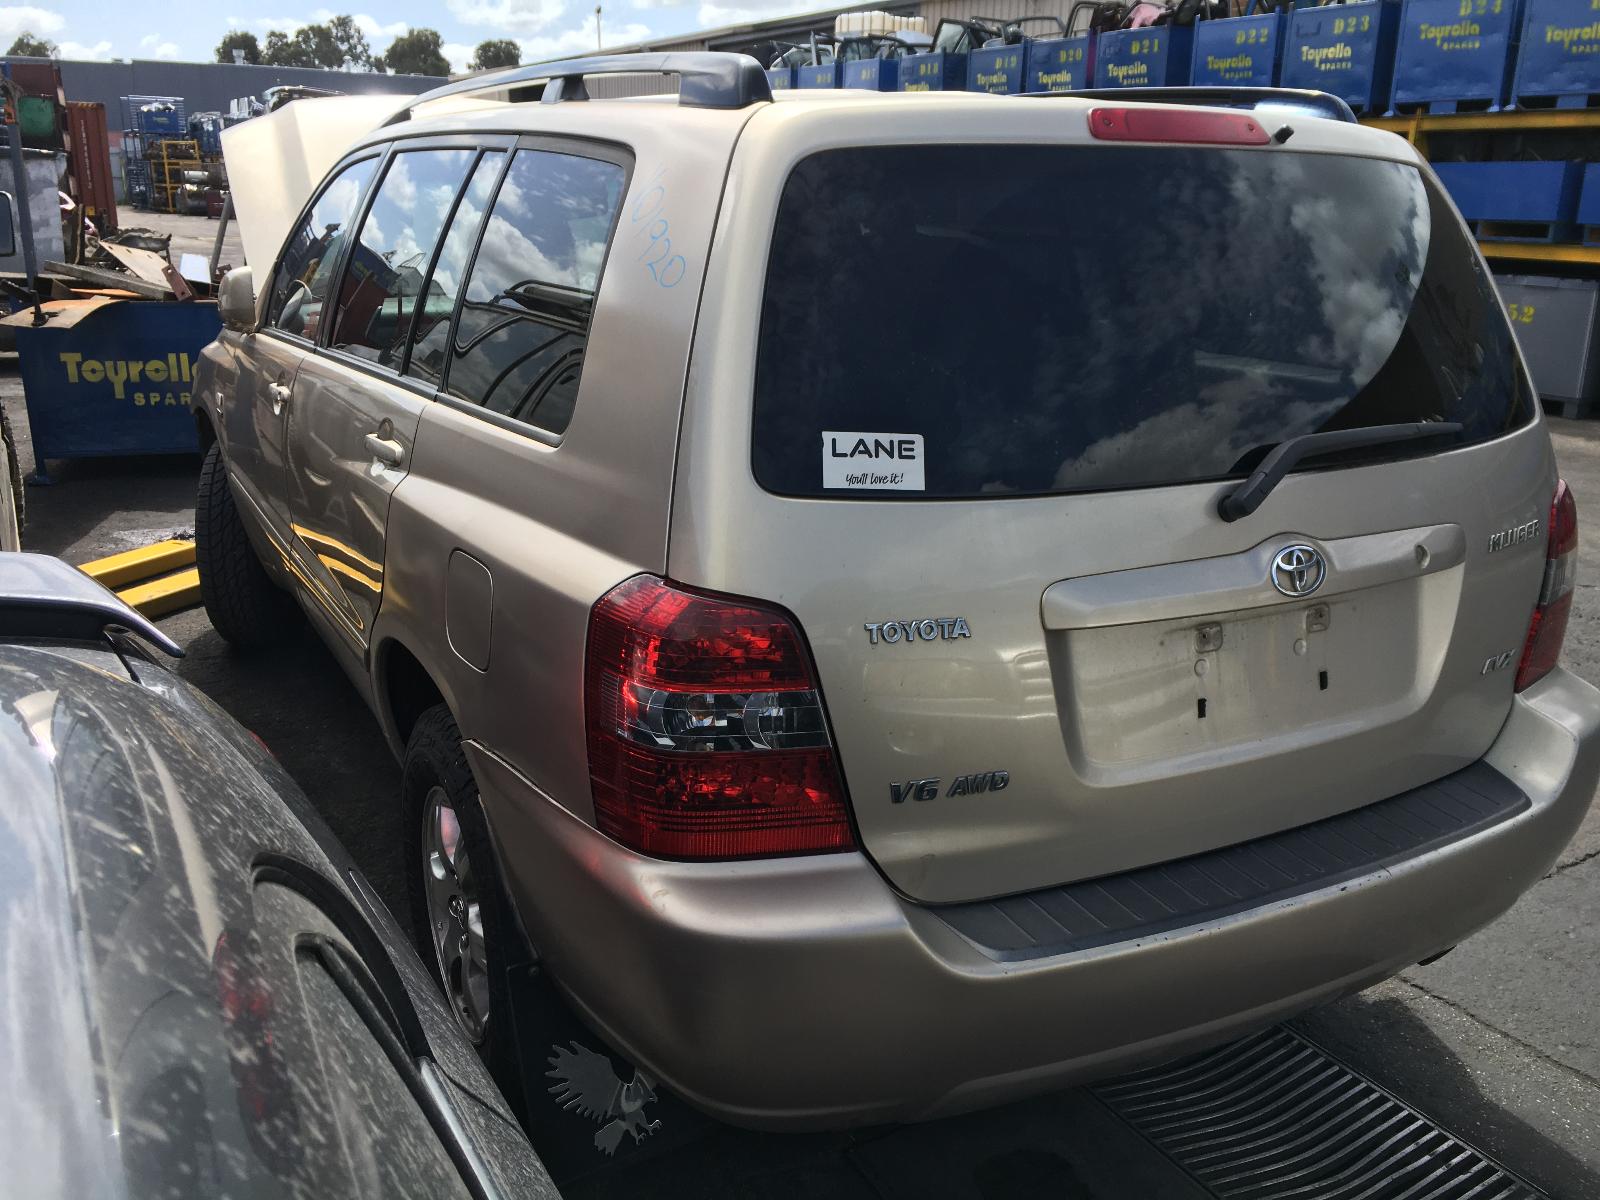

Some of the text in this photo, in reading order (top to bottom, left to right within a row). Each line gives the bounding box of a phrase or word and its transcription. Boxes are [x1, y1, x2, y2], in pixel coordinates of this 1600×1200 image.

[1235, 27, 1268, 45] D22
[1333, 15, 1370, 35] D23
[1419, 21, 1480, 47] Toyrolla
[1546, 22, 1600, 49] Toyroll
[1059, 47, 1083, 63] D20
[1131, 38, 1159, 55] D21
[1301, 42, 1352, 68] Toyrolla
[1107, 60, 1148, 83] Toyrolla
[1207, 53, 1253, 76] Toyrolla
[1038, 70, 1073, 90] Toyrolla
[133, 392, 192, 406] SPAR
[831, 437, 916, 460] LANE
[870, 472, 889, 485] love
[1489, 519, 1540, 553] KLUGER
[864, 616, 972, 645] TOYOTA
[889, 769, 1010, 804] V6 AWD
